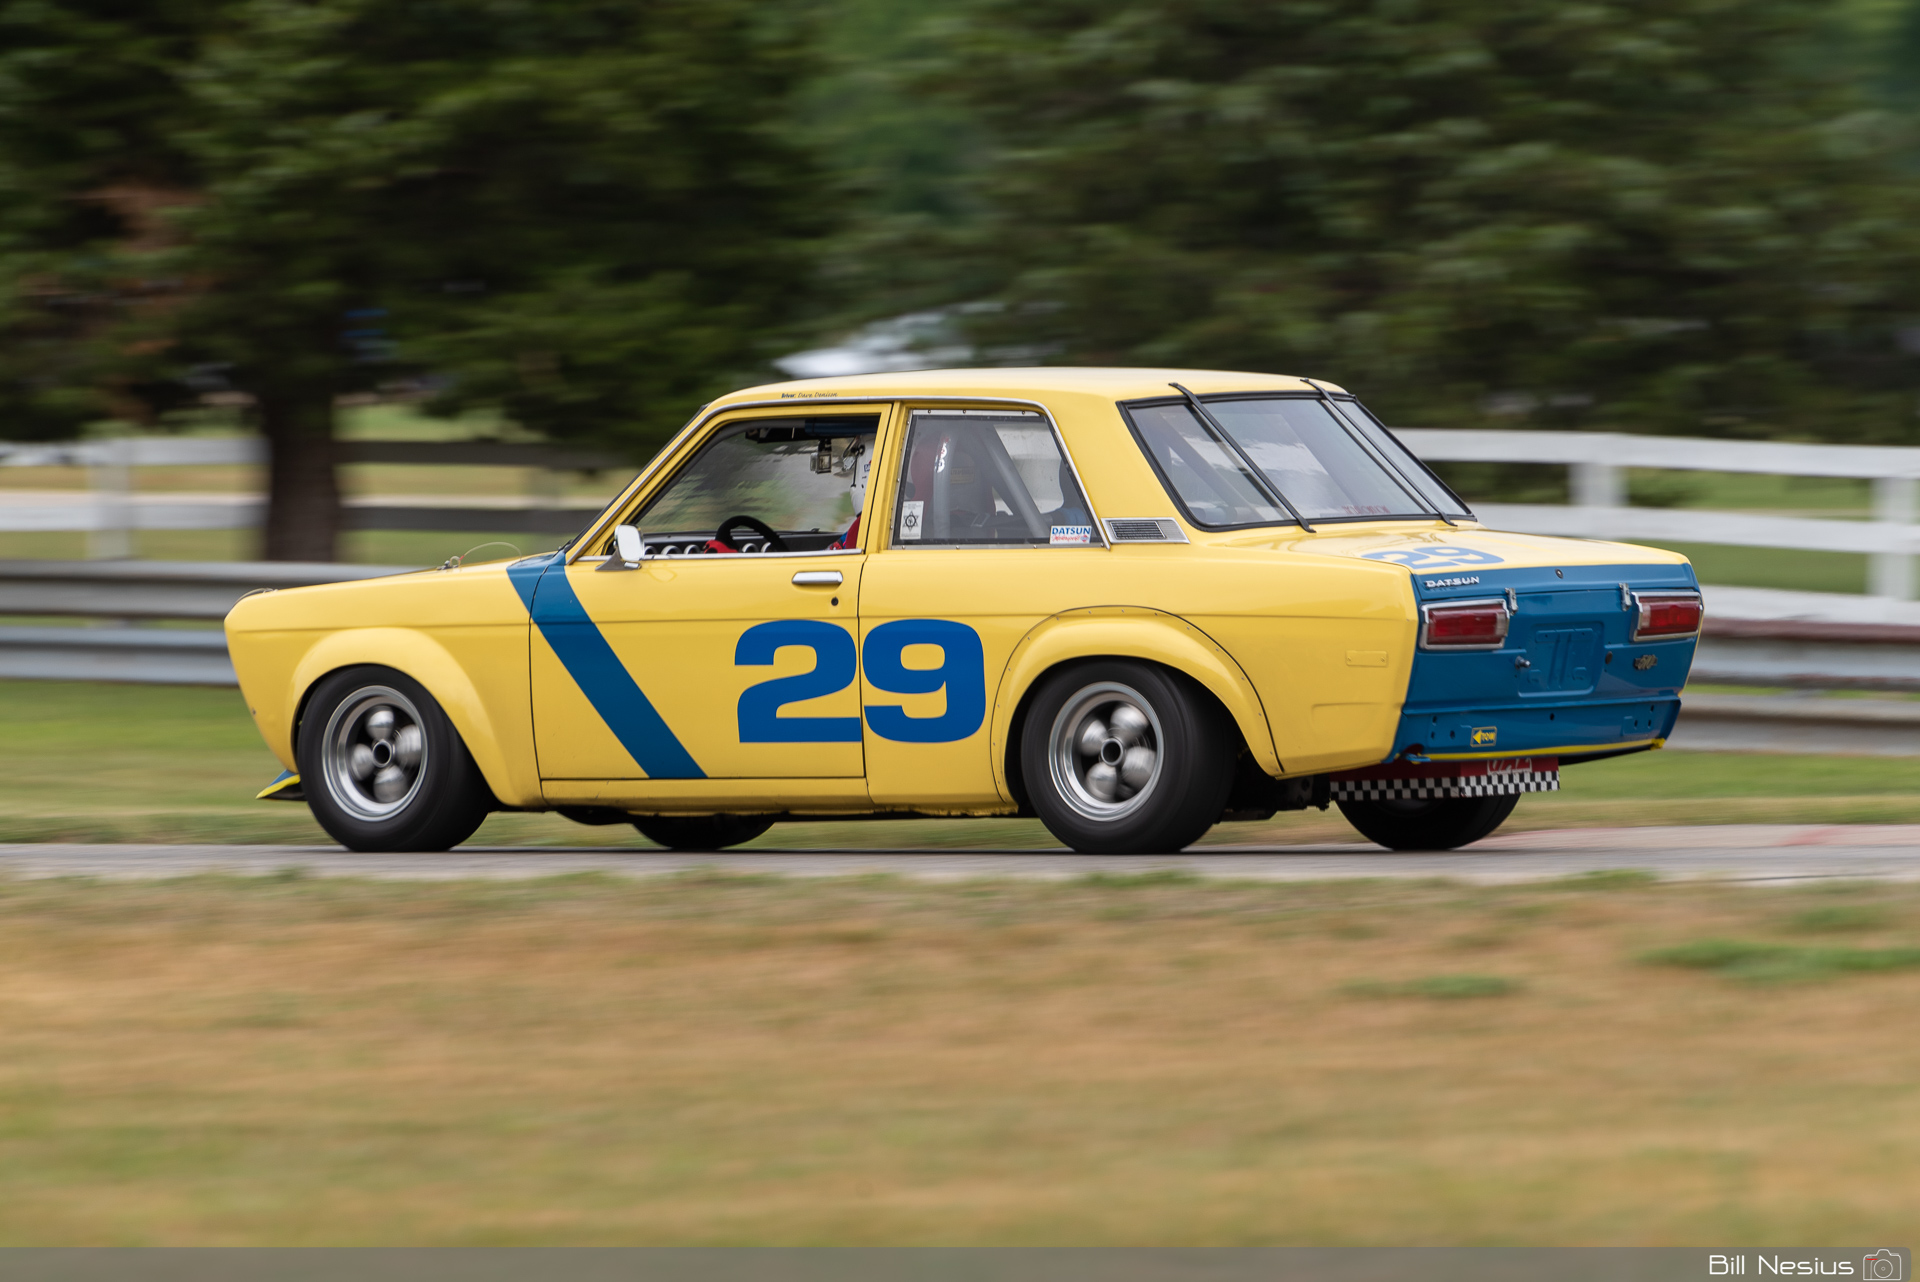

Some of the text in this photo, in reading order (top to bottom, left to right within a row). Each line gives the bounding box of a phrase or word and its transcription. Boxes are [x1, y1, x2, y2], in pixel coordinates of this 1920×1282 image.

[1052, 527, 1091, 535] DATSUN
[1361, 546, 1505, 569] 29
[1425, 576, 1480, 588] DATSUN
[734, 618, 986, 744] 29
[1480, 731, 1496, 742] TOW
